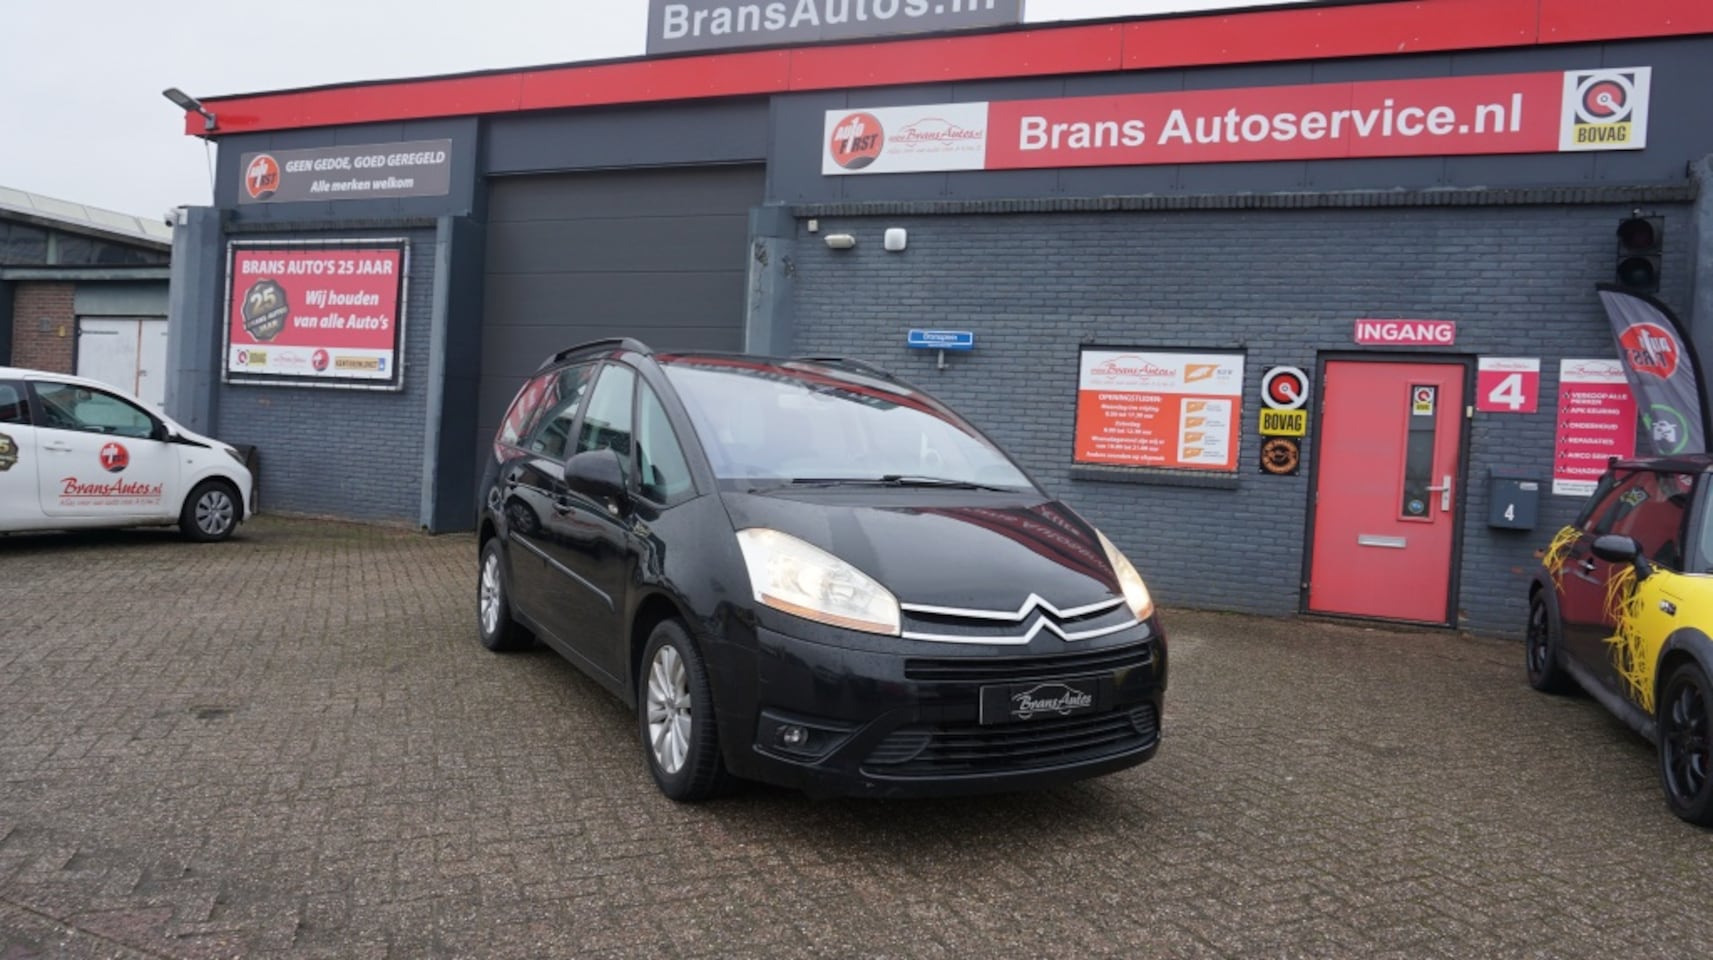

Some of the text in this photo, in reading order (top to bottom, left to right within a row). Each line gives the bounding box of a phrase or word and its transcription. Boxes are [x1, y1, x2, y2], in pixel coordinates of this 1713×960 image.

[662, 0, 995, 39] BransAutos.
[1019, 92, 1523, 151] Brans Autoservice.nl
[1577, 125, 1627, 143] BOVAG
[285, 151, 446, 173] GEEN GEDOE, GOED GEREGELD
[310, 177, 414, 193] Alle merken welkom
[242, 260, 393, 274] BRANS AUTO'S 25 JAAR
[250, 287, 276, 315] 25
[305, 290, 379, 308] Wij houden
[294, 314, 389, 330] van alle Auto's
[1357, 323, 1453, 342] INGANG
[1488, 373, 1525, 410] 4
[1264, 413, 1302, 431] BOVAG
[1504, 503, 1515, 521] 4
